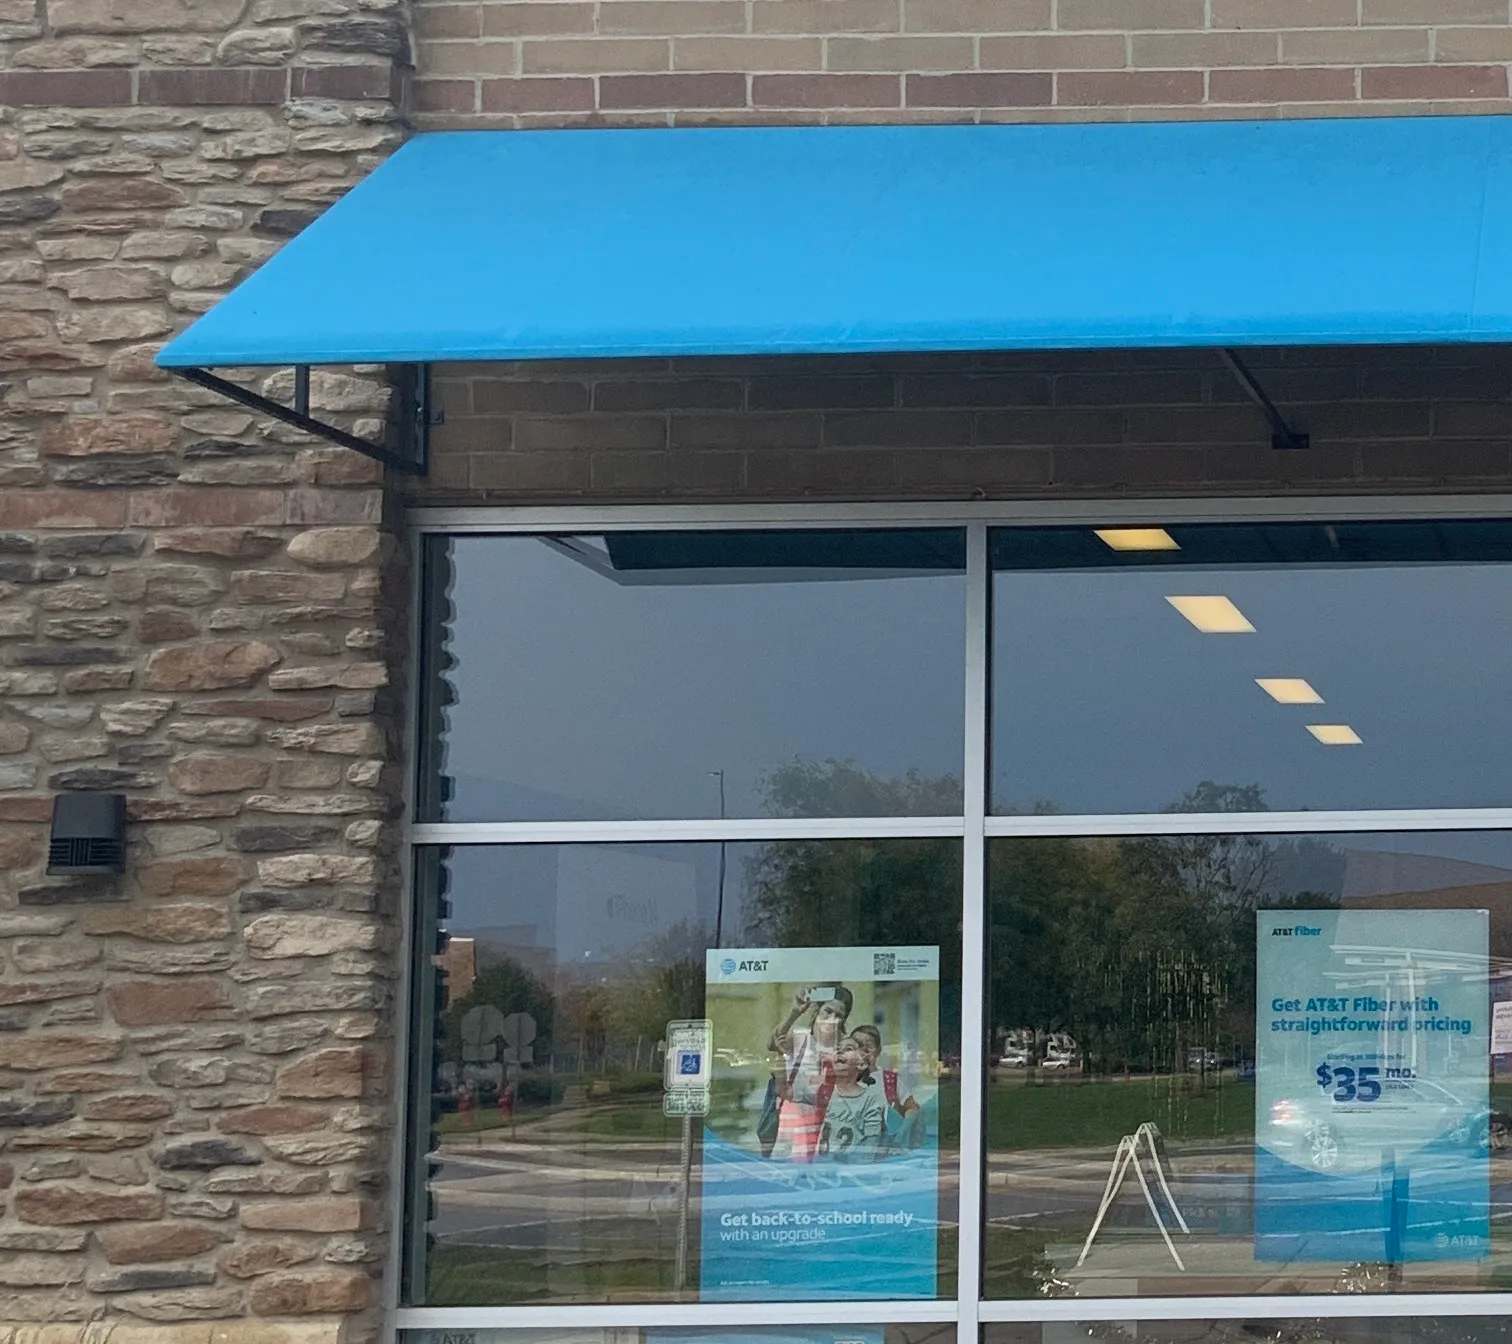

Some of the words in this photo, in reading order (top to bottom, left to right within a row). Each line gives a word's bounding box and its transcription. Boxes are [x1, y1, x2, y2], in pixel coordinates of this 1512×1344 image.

[1271, 928, 1293, 936] AT&T
[1294, 925, 1322, 936] fiber
[738, 960, 769, 972] AT&T
[1271, 998, 1300, 1012] Get
[1305, 997, 1349, 1012] AT&T
[1353, 997, 1394, 1012] Fiber
[1400, 996, 1439, 1012] with
[1271, 1016, 1408, 1035] straightforward
[1414, 1016, 1472, 1035] pricing
[1316, 1062, 1382, 1102] $35
[1385, 1067, 1417, 1079] mo.
[720, 1212, 749, 1227] Get
[751, 1210, 867, 1227] back-to-school
[870, 1210, 914, 1227] ready
[720, 1228, 749, 1241] with
[751, 1230, 769, 1241] an
[770, 1227, 826, 1243] upgrade
[1450, 1235, 1479, 1246] AT&T
